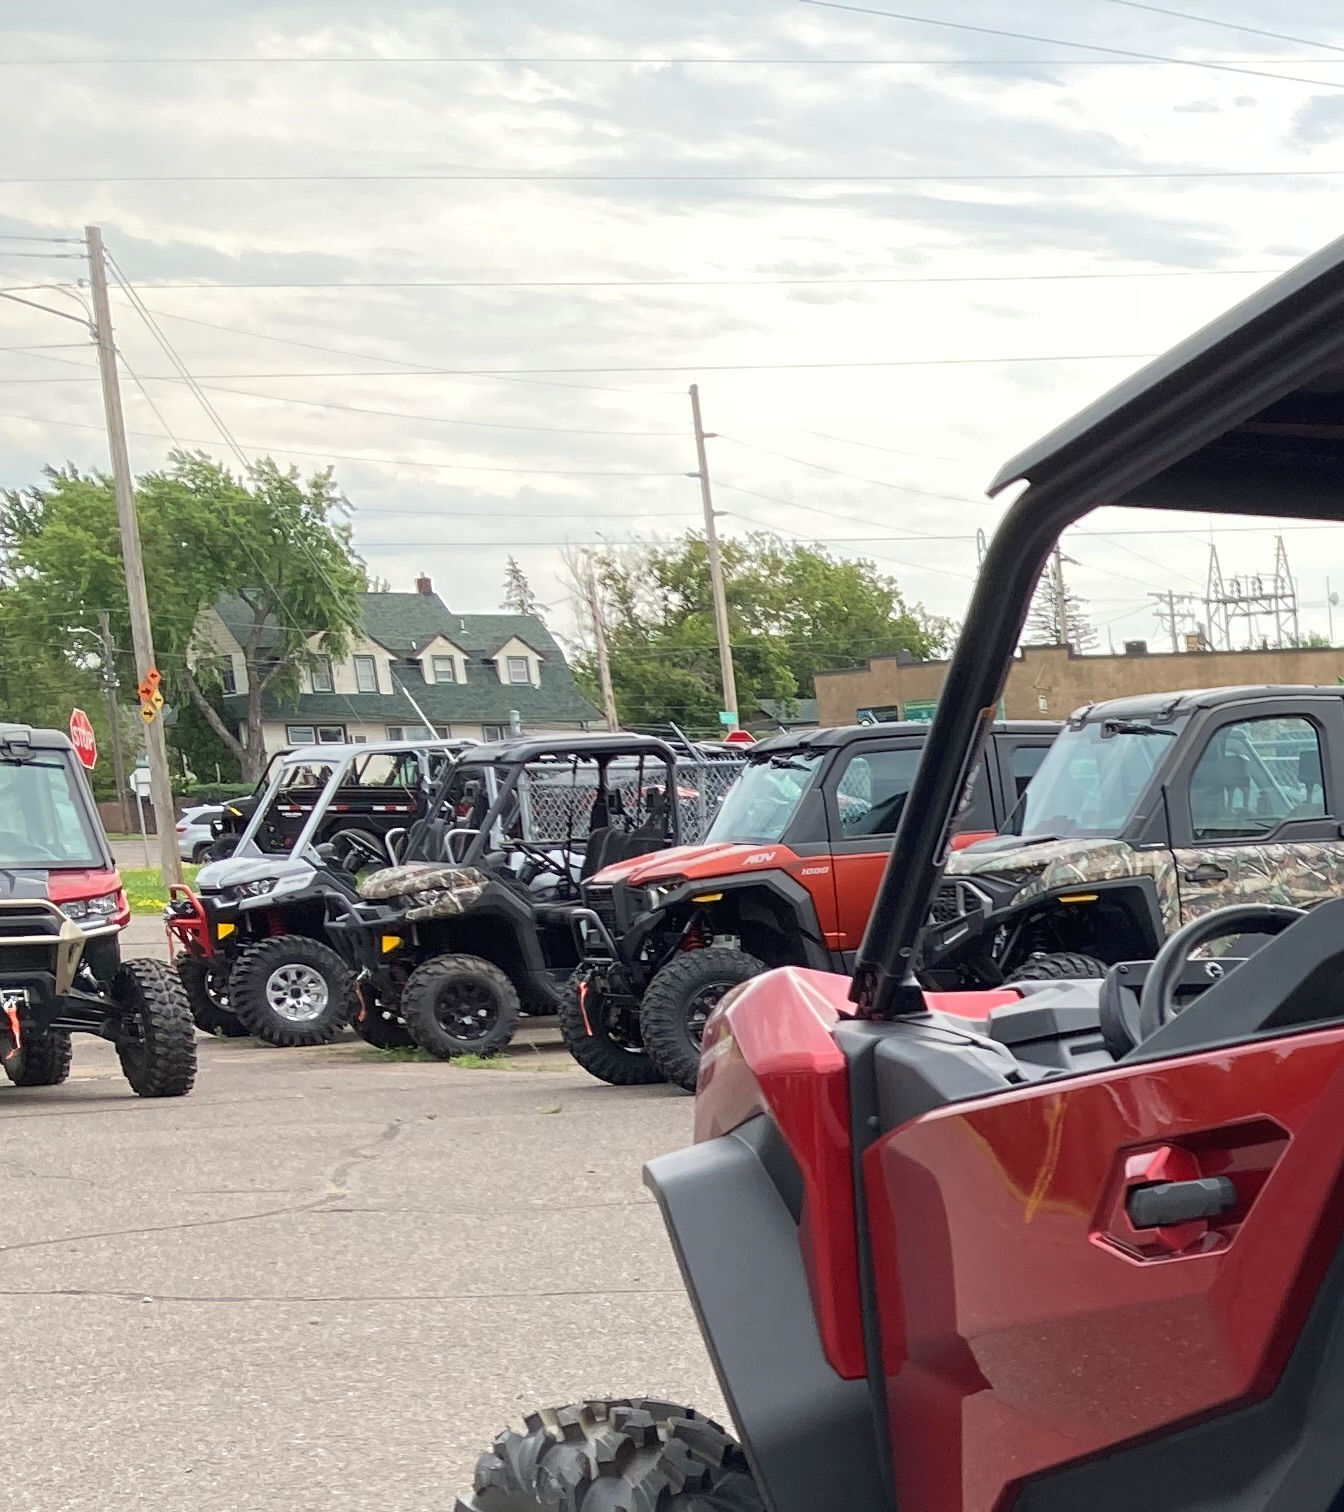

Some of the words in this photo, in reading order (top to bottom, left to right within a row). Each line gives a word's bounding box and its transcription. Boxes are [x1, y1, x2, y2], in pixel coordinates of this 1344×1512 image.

[72, 726, 94, 751] STOP
[742, 851, 777, 865] ADV
[801, 866, 829, 875] 1000
